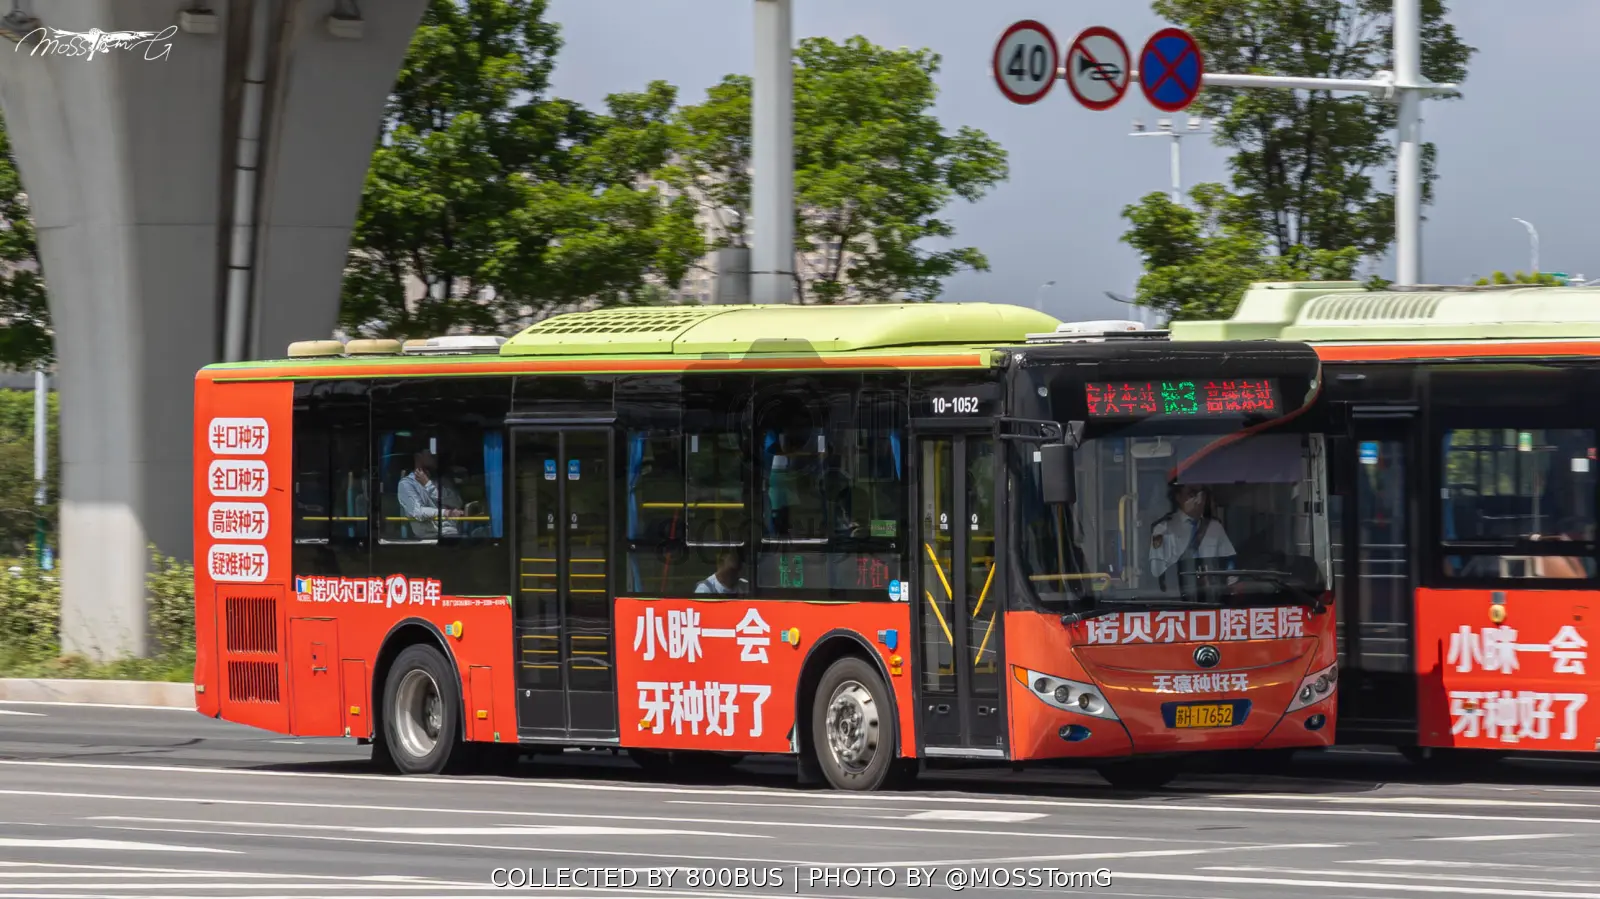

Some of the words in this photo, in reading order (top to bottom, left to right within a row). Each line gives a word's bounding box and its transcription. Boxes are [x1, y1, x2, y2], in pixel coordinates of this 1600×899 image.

[1007, 44, 1047, 81] 40
[932, 397, 979, 413] 10-1052
[212, 425, 265, 449] 半口种牙
[212, 467, 265, 491] 全口种牙
[212, 510, 265, 534] 高龄种牙
[212, 551, 265, 576] 疑难种牙
[634, 608, 770, 663] 小眯一会
[1085, 606, 1304, 644] 诺贝尔口腔医院
[1447, 625, 1588, 674] 小眯一会
[1152, 673, 1249, 693] 无痛种好牙
[636, 681, 771, 737] 牙种好了
[1450, 690, 1588, 742] 牙种好了
